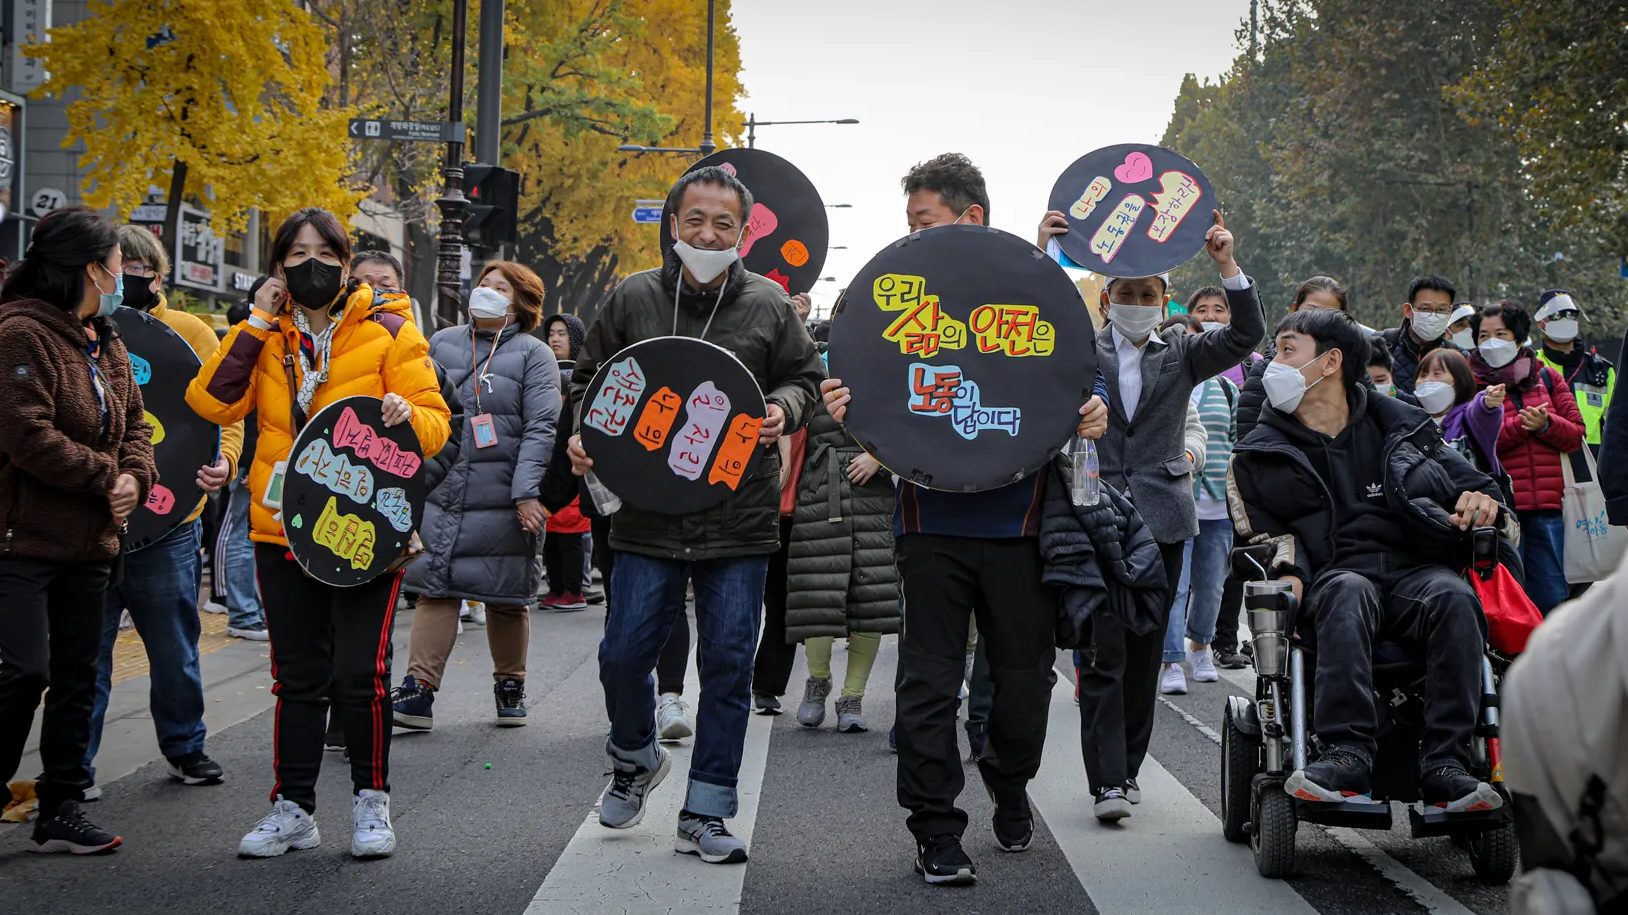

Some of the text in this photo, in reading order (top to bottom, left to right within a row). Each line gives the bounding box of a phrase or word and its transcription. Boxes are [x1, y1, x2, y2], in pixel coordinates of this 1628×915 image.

[36, 194, 58, 210] 21
[1076, 181, 1108, 213] 나의
[1096, 202, 1140, 253] 노동권을
[877, 276, 923, 306] 우리
[888, 300, 1051, 356] 삶의 안전은
[589, 359, 642, 435] 생존권
[911, 367, 975, 413] 노동이
[638, 393, 674, 445] 나의
[953, 402, 1021, 435] 답이다
[718, 421, 756, 477] 나의
[316, 506, 374, 566] 열심히
